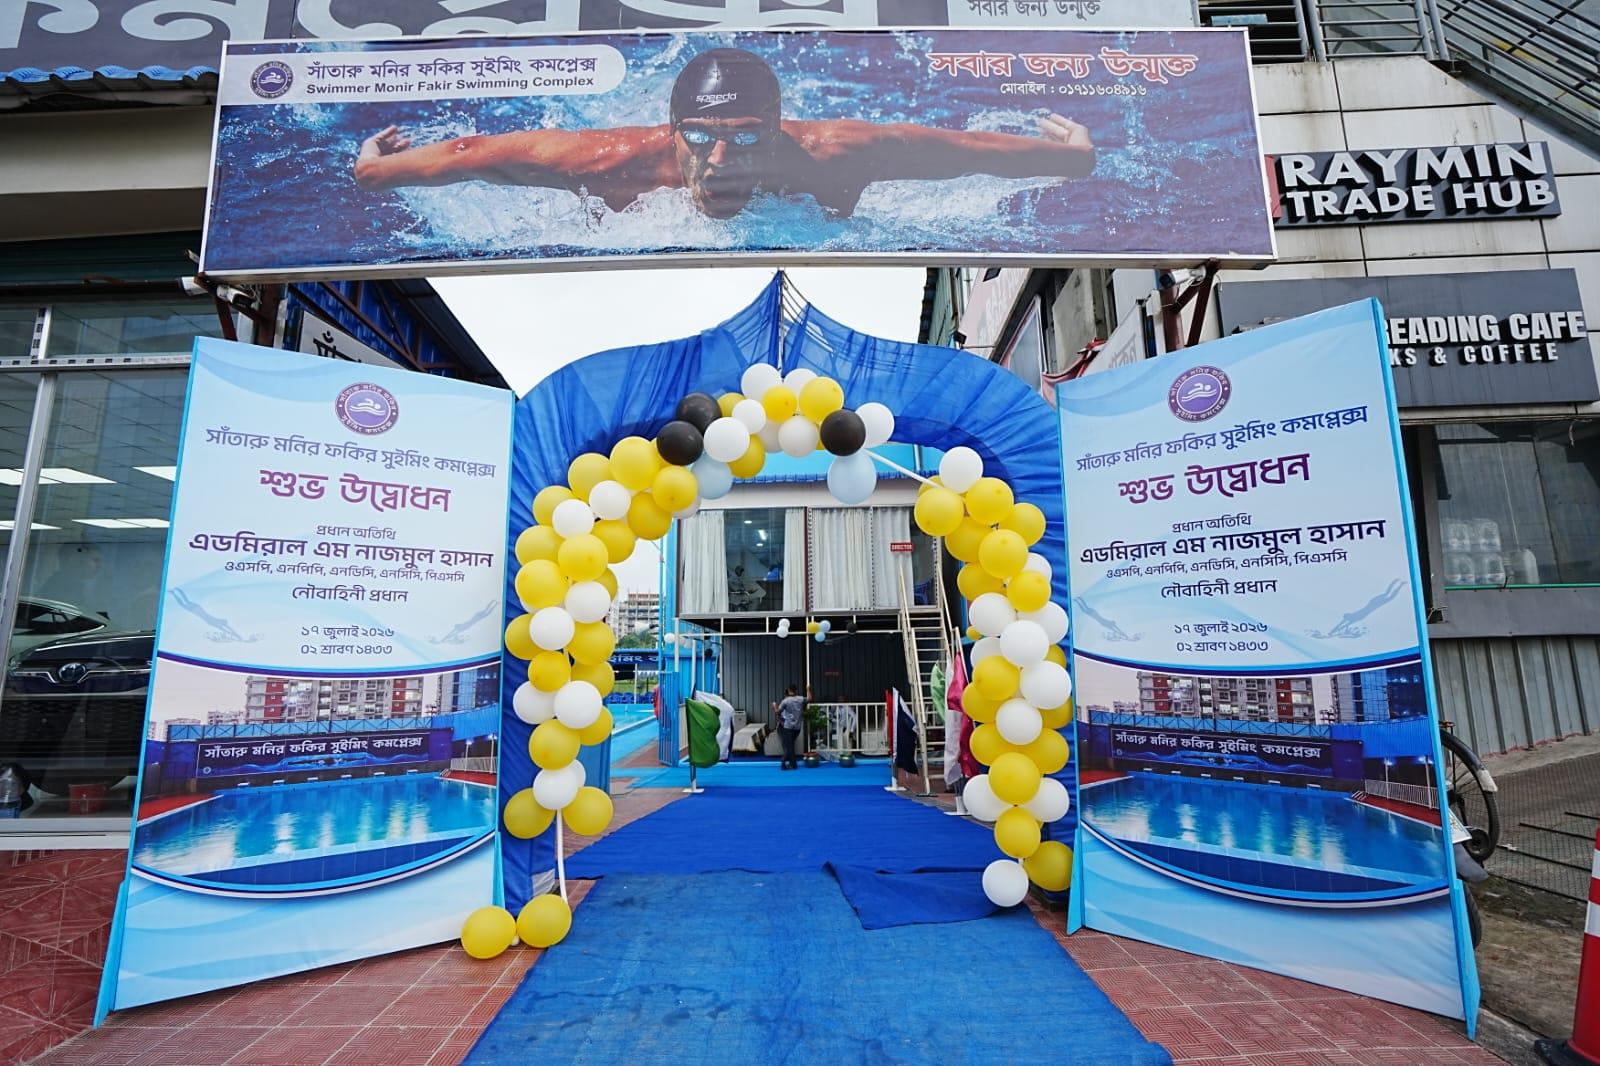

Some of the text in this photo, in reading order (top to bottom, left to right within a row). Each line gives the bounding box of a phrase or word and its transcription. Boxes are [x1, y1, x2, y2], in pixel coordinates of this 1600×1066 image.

[307, 55, 598, 79] সাঁতারু মনির ফকির সুইমিং কমপ্লেক্স
[926, 47, 1199, 84] সবার জন্য উন্মুক্ত
[306, 76, 594, 94] Swimmer Monir Fakir Swimming Complex
[1000, 80, 1047, 95] মোবাইল
[1280, 142, 1547, 187] RAYMIN
[1286, 180, 1554, 216] TRADE HUB
[1385, 311, 1587, 345] EADING CAFE
[1434, 347, 1447, 364] &
[1464, 342, 1559, 362] COFFEE
[1076, 406, 1368, 471] সাঁতারু মনির ফকির সুইমিং কমপ্লেক্স
[206, 426, 496, 478] সাঁতারু মনির ফকির সুইমিং কমপ্লেক্স
[1118, 453, 1310, 504] শুভ উদ্বোধন
[259, 469, 451, 512] শুভ উদ্বোধন
[316, 524, 397, 540] প্রধান অতিথি
[1172, 513, 1252, 533] প্রধান অতিথি
[189, 531, 494, 569] এডমিরাল এম নাজমুল হাসান
[1080, 520, 1386, 563] এডমিরাল এম নাজমুল হাসান
[224, 560, 465, 583] ওএসপি, এনপিপি, এনডিসি, এনসিসি, পিএসসি
[1106, 549, 1348, 578] ওএসপি, এনপিপি, এনডিসি, এনসিসি, পিএসসি
[292, 583, 408, 602] নৌবাহিনী প্রধান
[1161, 578, 1278, 598] নৌবাহিনী প্রধান
[301, 625, 395, 639] ১৭ জুলাই ২০২৬
[1174, 621, 1268, 636] ১৭ জুলাই ২০২৬
[301, 644, 393, 655] ০২ শ্রাবণ ১৪৩৩
[1176, 641, 1269, 652] ০২ শ্রাবণ ১৪৩৩
